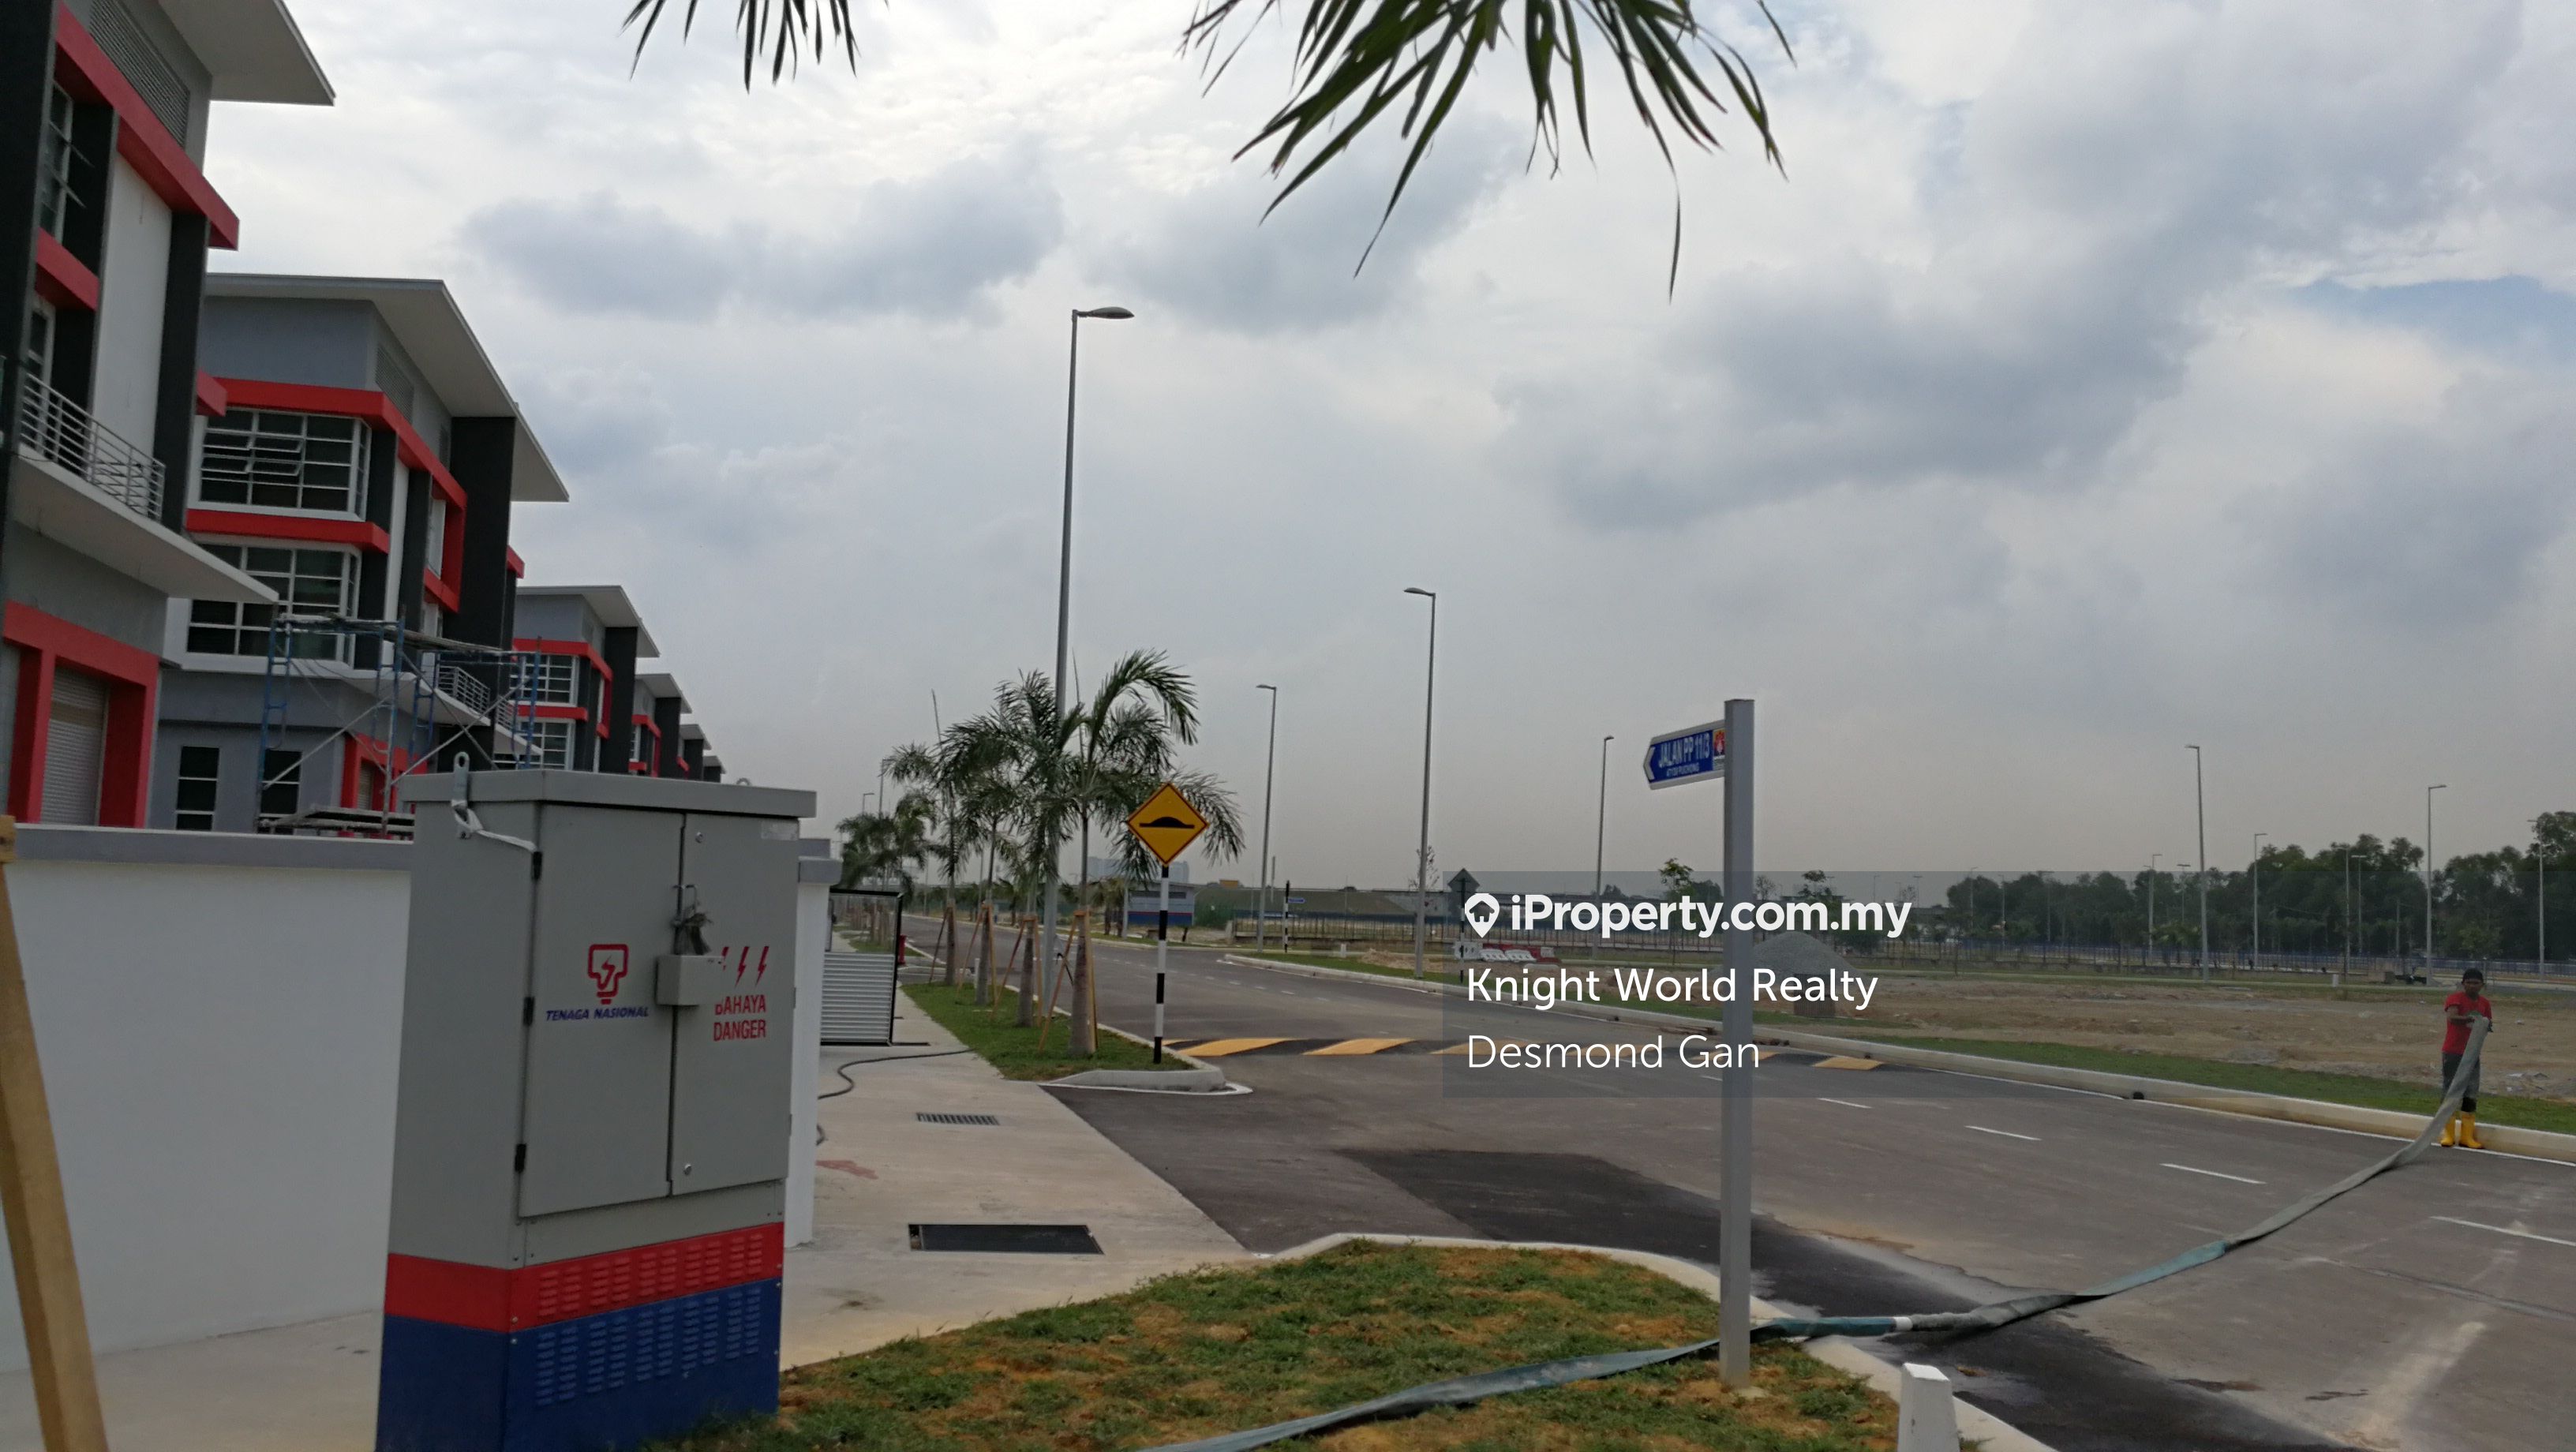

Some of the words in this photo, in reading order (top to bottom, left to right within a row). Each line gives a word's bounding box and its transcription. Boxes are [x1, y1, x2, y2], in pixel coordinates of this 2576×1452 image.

[1659, 739, 1683, 768] JALAN
[1683, 736, 1694, 762] PP
[546, 1009, 589, 1021] TENAGA
[593, 1007, 649, 1019] NASIONAL
[713, 1019, 766, 1042] DANGER
